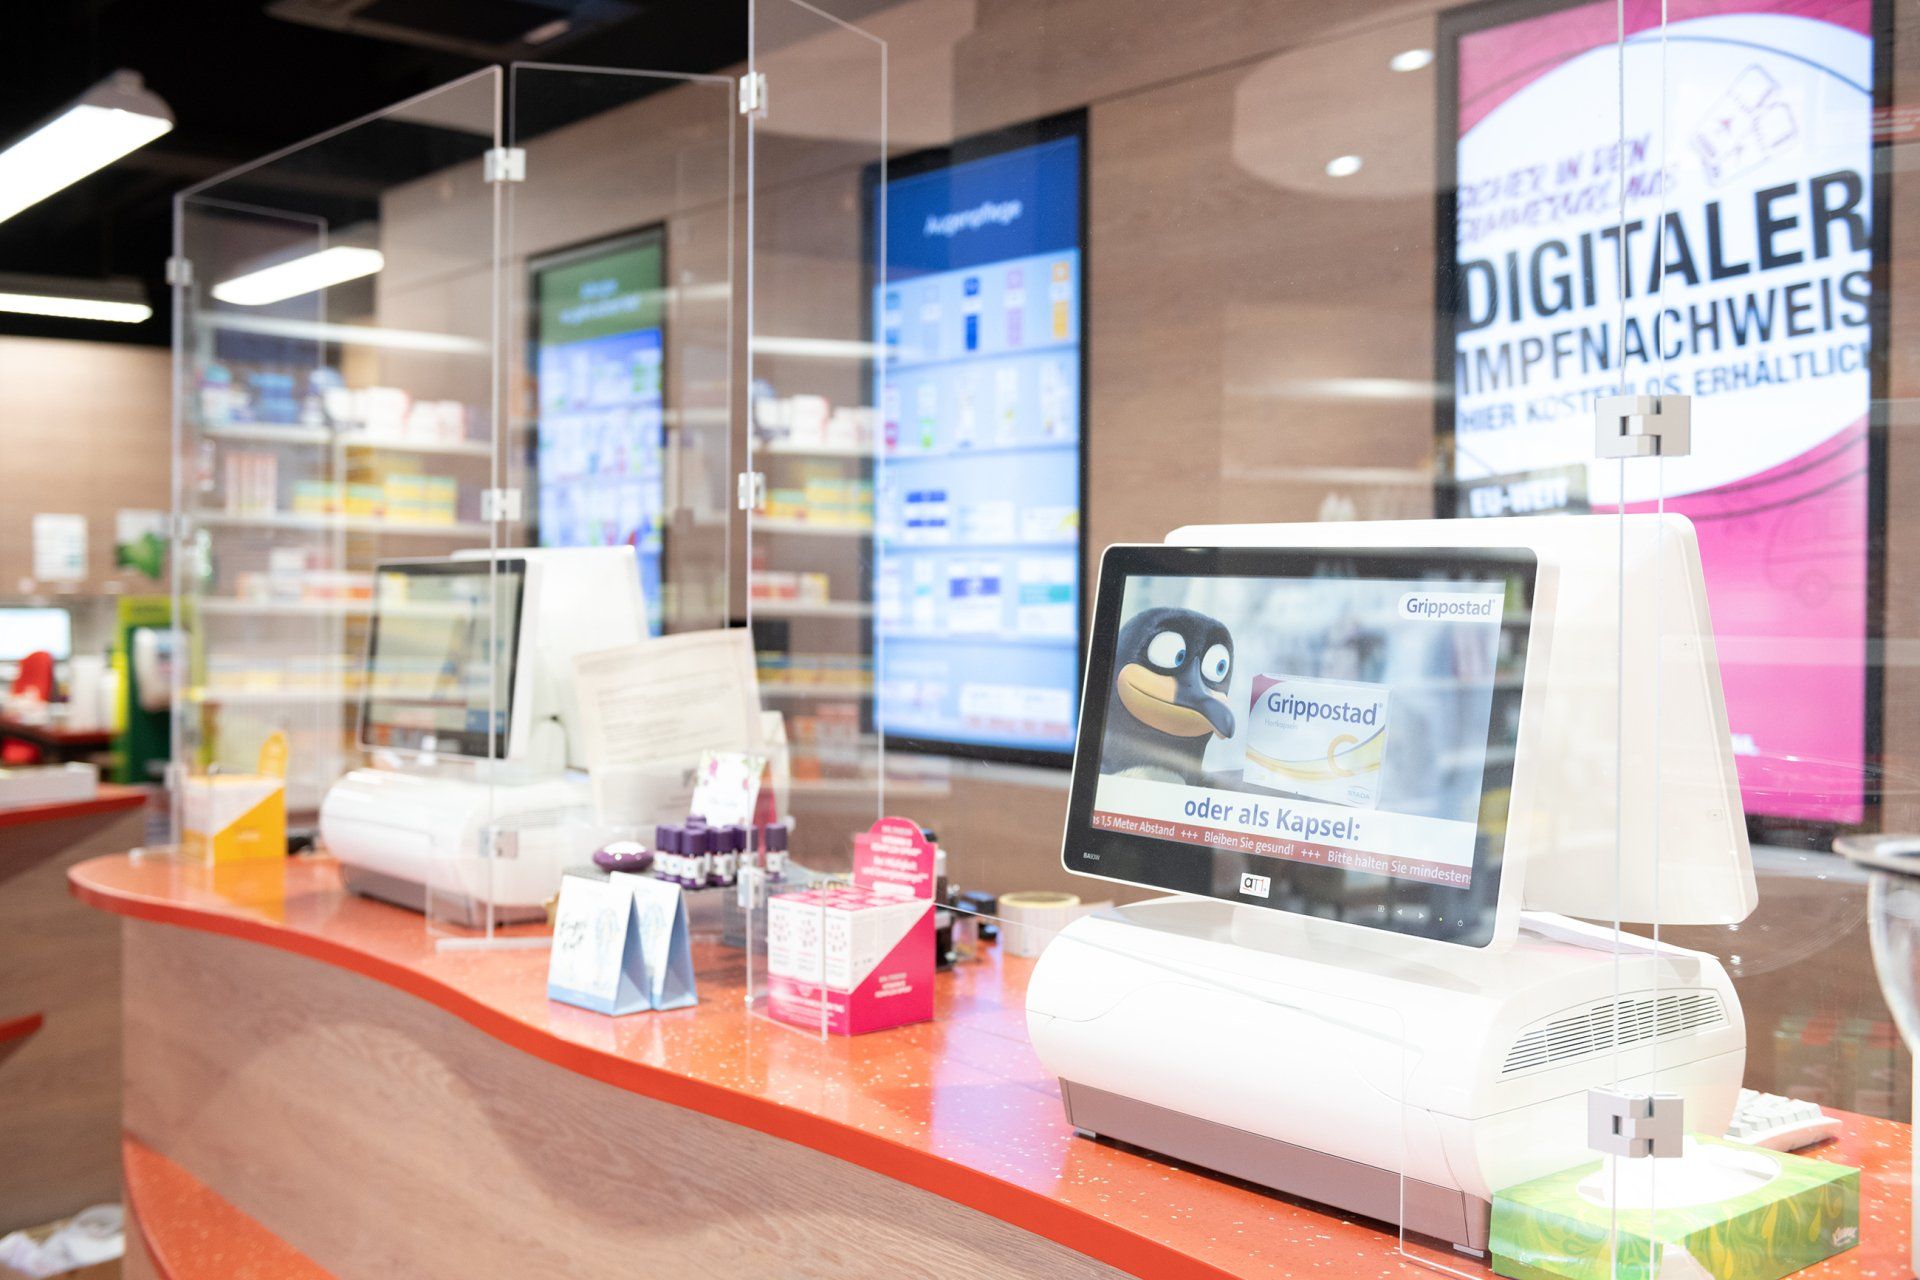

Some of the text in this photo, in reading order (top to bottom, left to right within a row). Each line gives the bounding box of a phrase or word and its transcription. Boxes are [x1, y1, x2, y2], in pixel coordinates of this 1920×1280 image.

[1458, 169, 1871, 333] DIGITALER
[1457, 270, 1871, 396] IMPFNACHWEIS
[1100, 815, 1113, 828] 1,5
[1112, 816, 1139, 831] Meter
[1139, 821, 1176, 837] Abstand
[1204, 831, 1238, 848] Bleiben
[1240, 837, 1254, 850] Sie
[1256, 841, 1294, 856] gesund!
[1327, 850, 1353, 865] Bitte
[1354, 856, 1389, 872] halten
[1391, 860, 1407, 874] Sie
[1184, 797, 1361, 841] oder als Kapsel:
